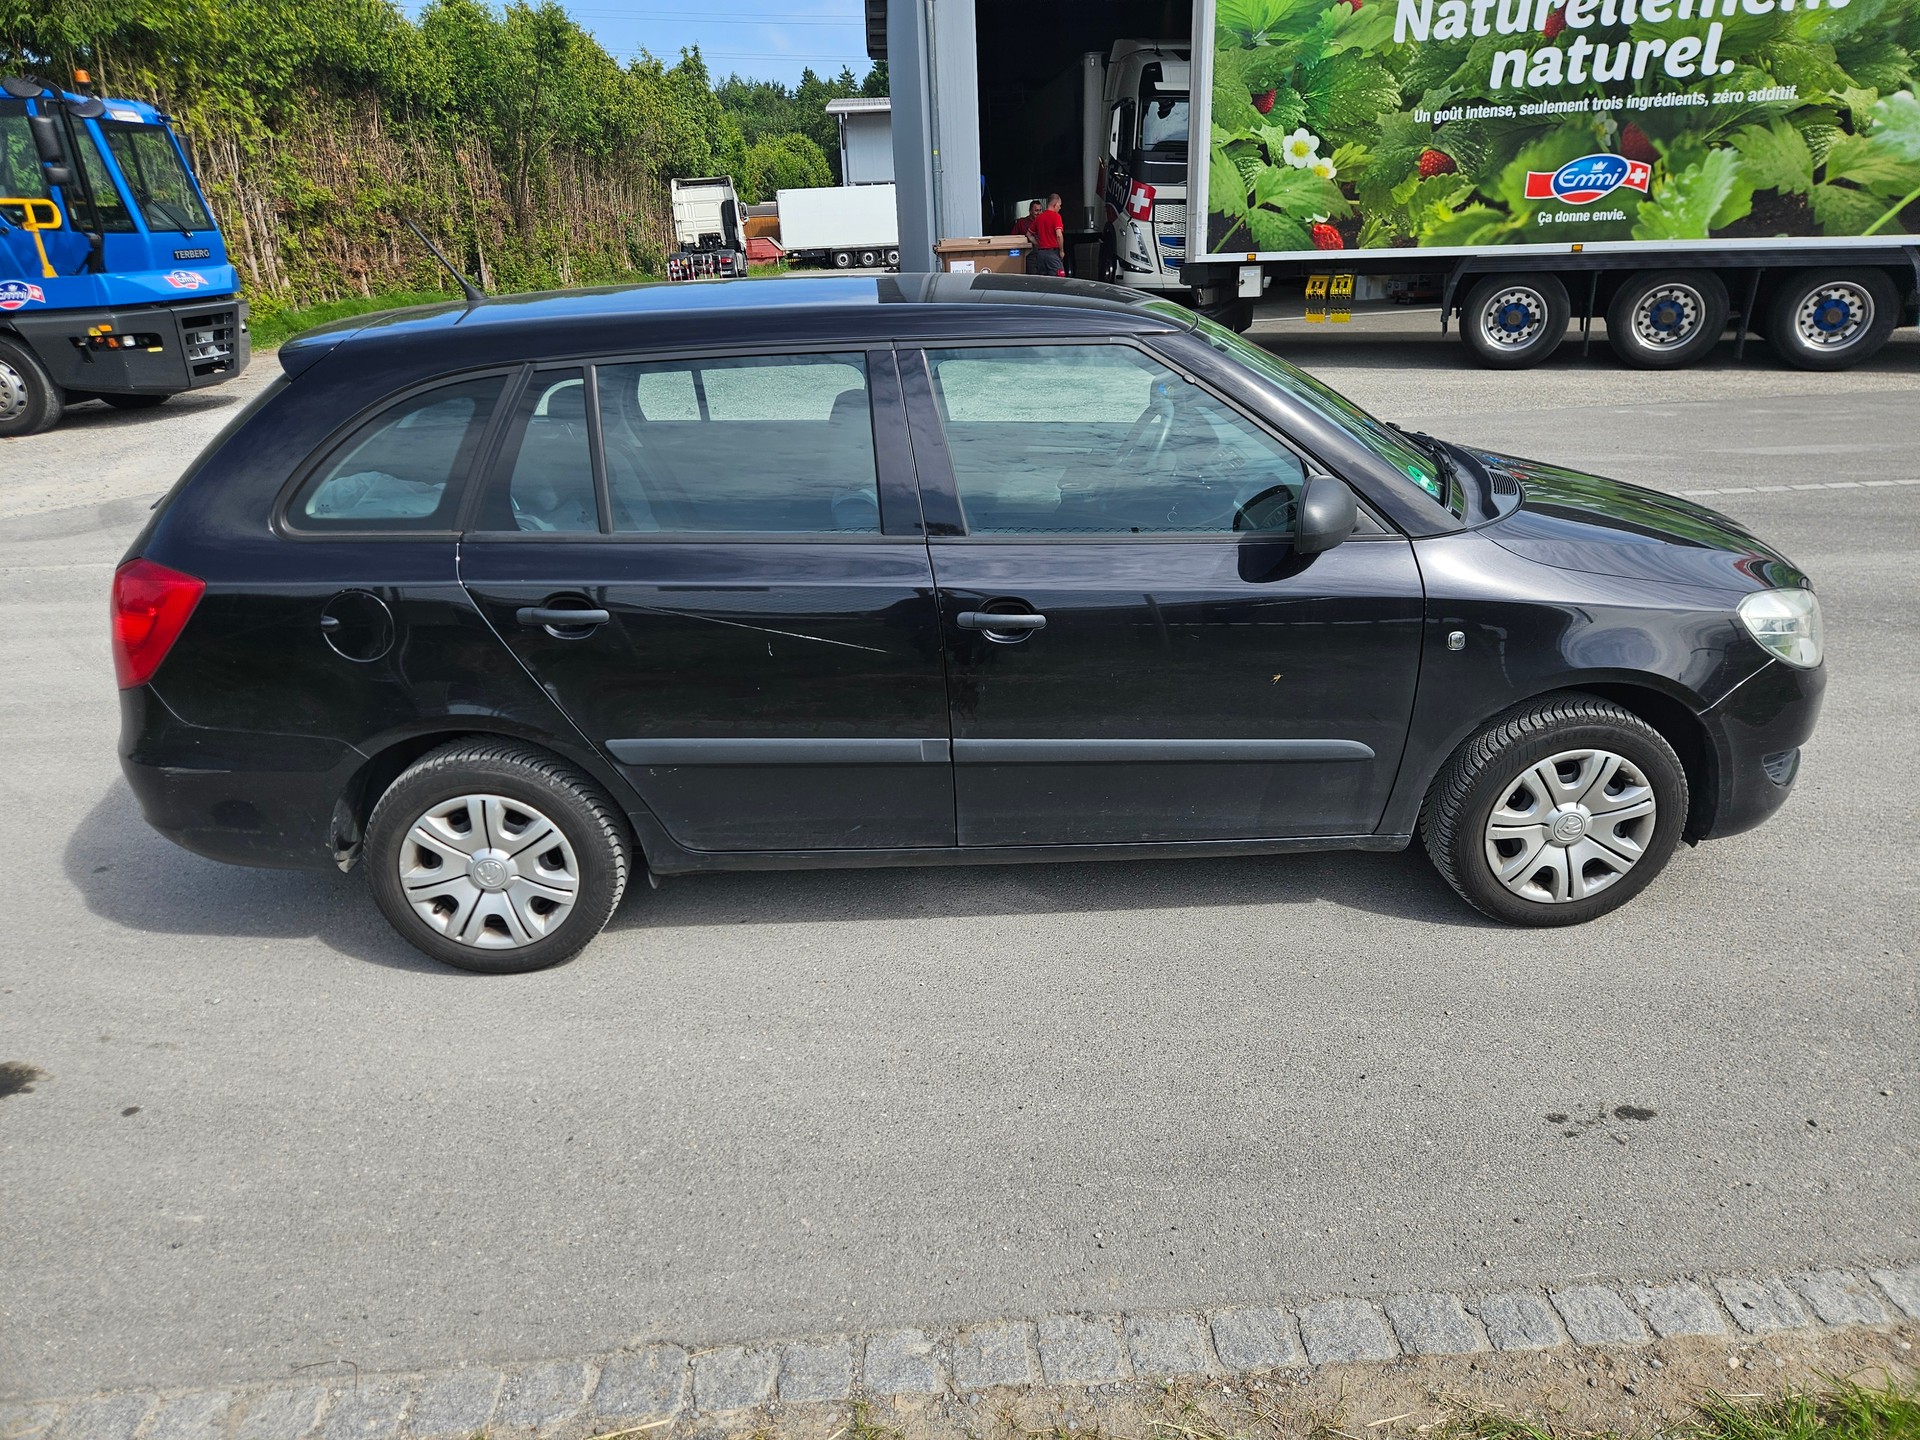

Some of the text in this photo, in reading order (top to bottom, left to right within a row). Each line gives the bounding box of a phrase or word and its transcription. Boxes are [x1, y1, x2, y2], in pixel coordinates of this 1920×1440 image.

[1489, 22, 1735, 90] naturel.
[1414, 84, 1800, 125] Un goût intense, seulement trois ingrédients, zéro additif.
[1558, 167, 1622, 187] Emmi
[1537, 208, 1627, 226] Ça donne envie.
[174, 249, 210, 259] TERBERG
